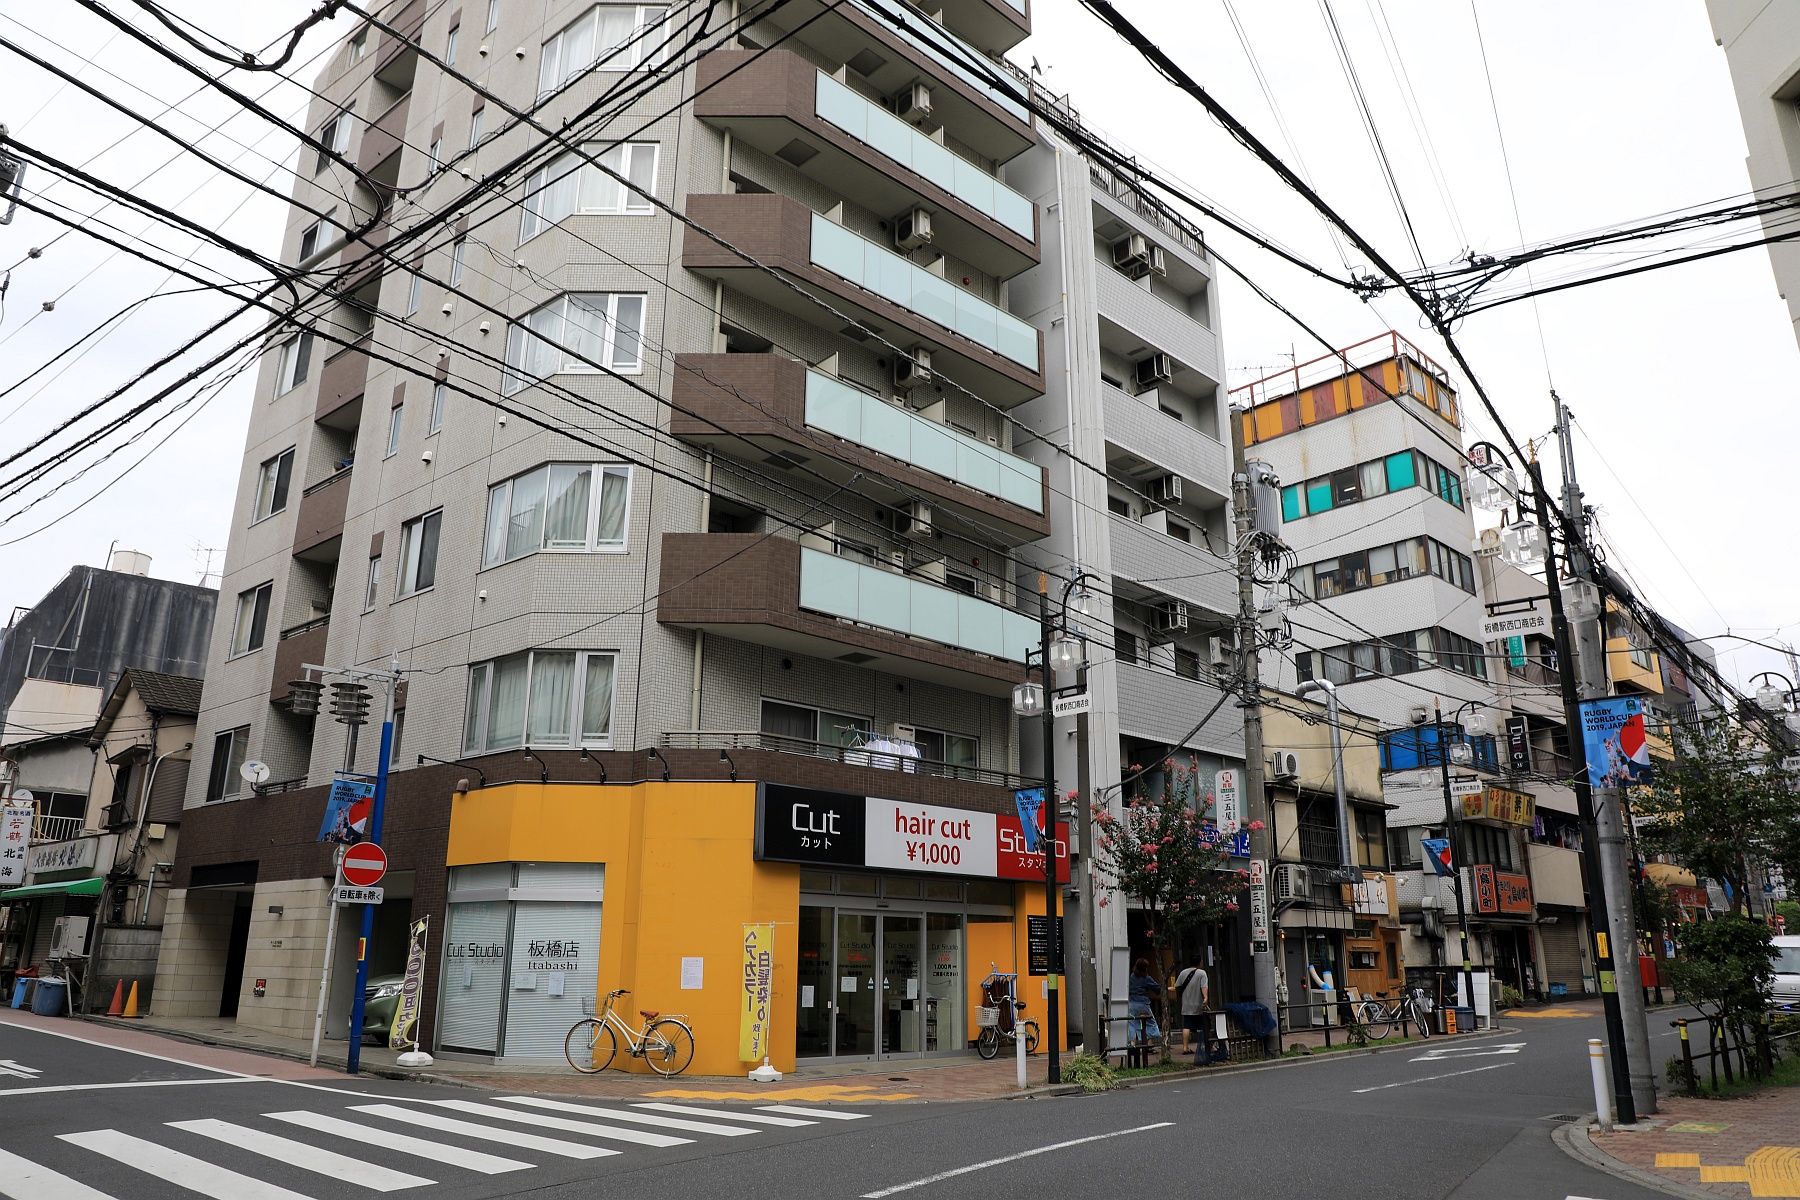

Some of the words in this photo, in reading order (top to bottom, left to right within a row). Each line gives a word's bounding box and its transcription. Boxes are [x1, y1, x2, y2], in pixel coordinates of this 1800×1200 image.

[1484, 616, 1545, 634] 板橋駅西口商店会
[1584, 709, 1611, 717] RUGBY
[1585, 715, 1615, 724] WORLD
[1616, 713, 1633, 721] CUP
[1587, 724, 1608, 732] 2019,
[1608, 721, 1635, 729] JAPAN
[1224, 794, 1233, 821] 三五屋
[792, 802, 840, 836] Cut
[895, 807, 935, 838] hair
[940, 818, 971, 841] cut
[801, 837, 832, 850] カット
[906, 840, 961, 866] ¥1,000
[1, 848, 16, 877] 北海
[339, 889, 381, 901] 自転車を除く
[1480, 872, 1492, 909] 鳥小町
[1252, 892, 1262, 928] 三五屋
[447, 942, 465, 957] Cut
[468, 942, 504, 958] Studio
[528, 940, 580, 958] 板橋店
[528, 961, 579, 970] Itabashi
